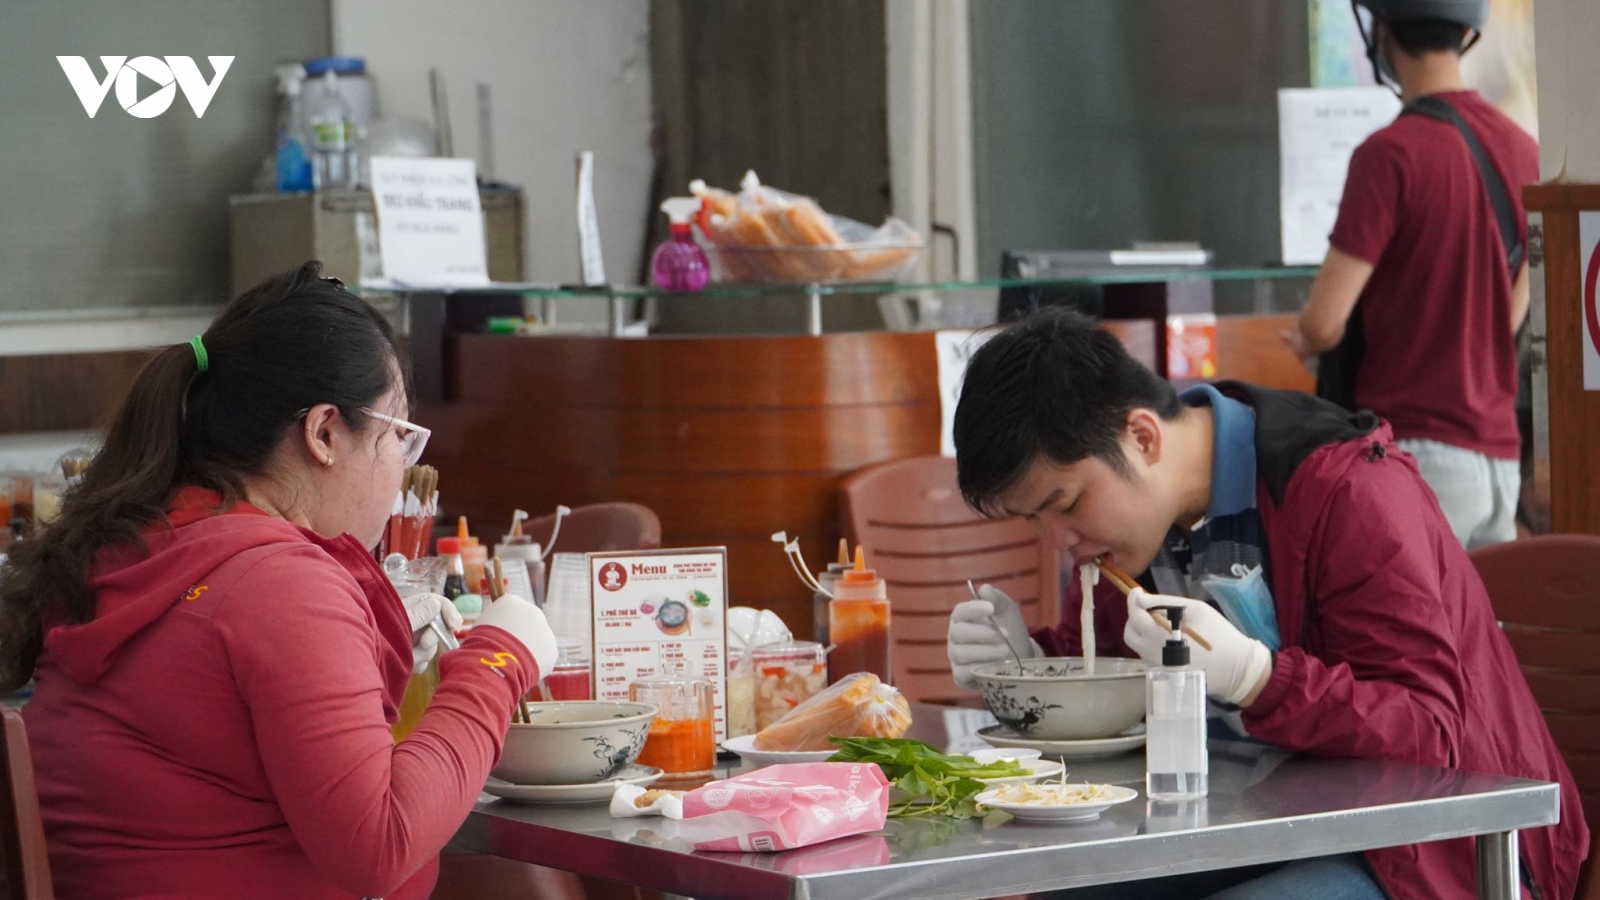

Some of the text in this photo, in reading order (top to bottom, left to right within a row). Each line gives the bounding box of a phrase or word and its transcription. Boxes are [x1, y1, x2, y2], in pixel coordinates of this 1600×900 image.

[435, 197, 474, 212] TRANG
[631, 563, 667, 574] Menu
[605, 609, 618, 617] PHỞ
